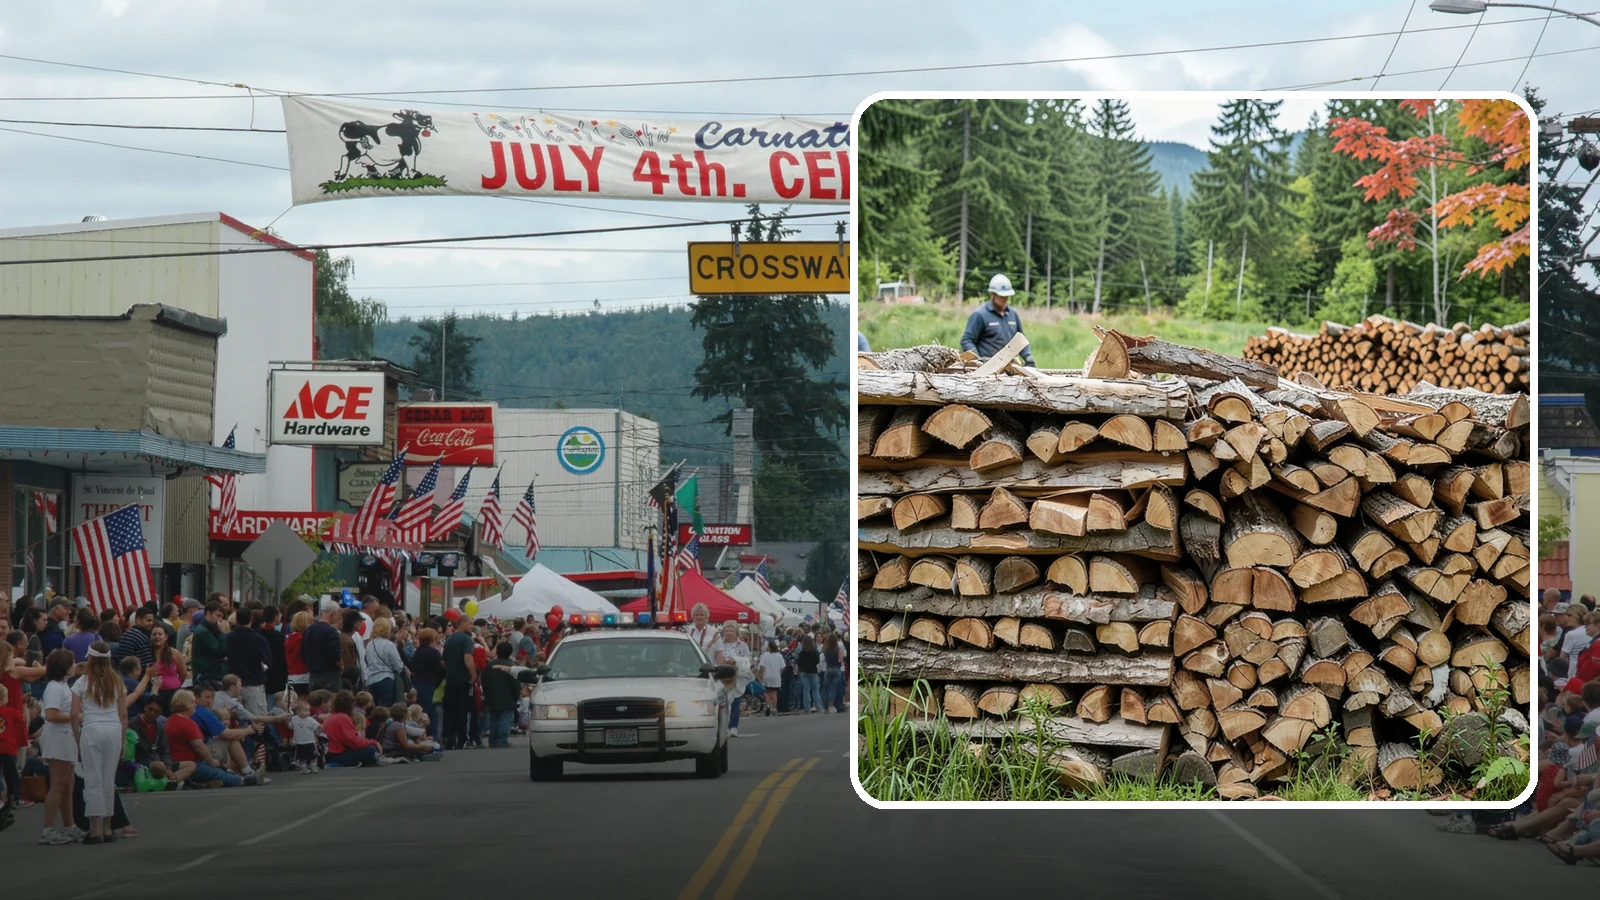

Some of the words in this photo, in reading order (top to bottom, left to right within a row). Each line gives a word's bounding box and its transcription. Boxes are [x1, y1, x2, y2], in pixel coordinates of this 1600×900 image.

[481, 141, 604, 192] JULY
[632, 149, 746, 197] 4th.
[697, 254, 850, 280] CROSSWA
[283, 380, 373, 420] ACE
[406, 409, 452, 422] CEDAR
[283, 421, 370, 436] Hardware
[416, 428, 476, 446] Coca-Cola
[83, 485, 94, 494] St.
[96, 485, 124, 495] Vincent
[126, 485, 135, 495] de
[138, 485, 155, 496] Paul
[688, 526, 741, 535] CRNATION
